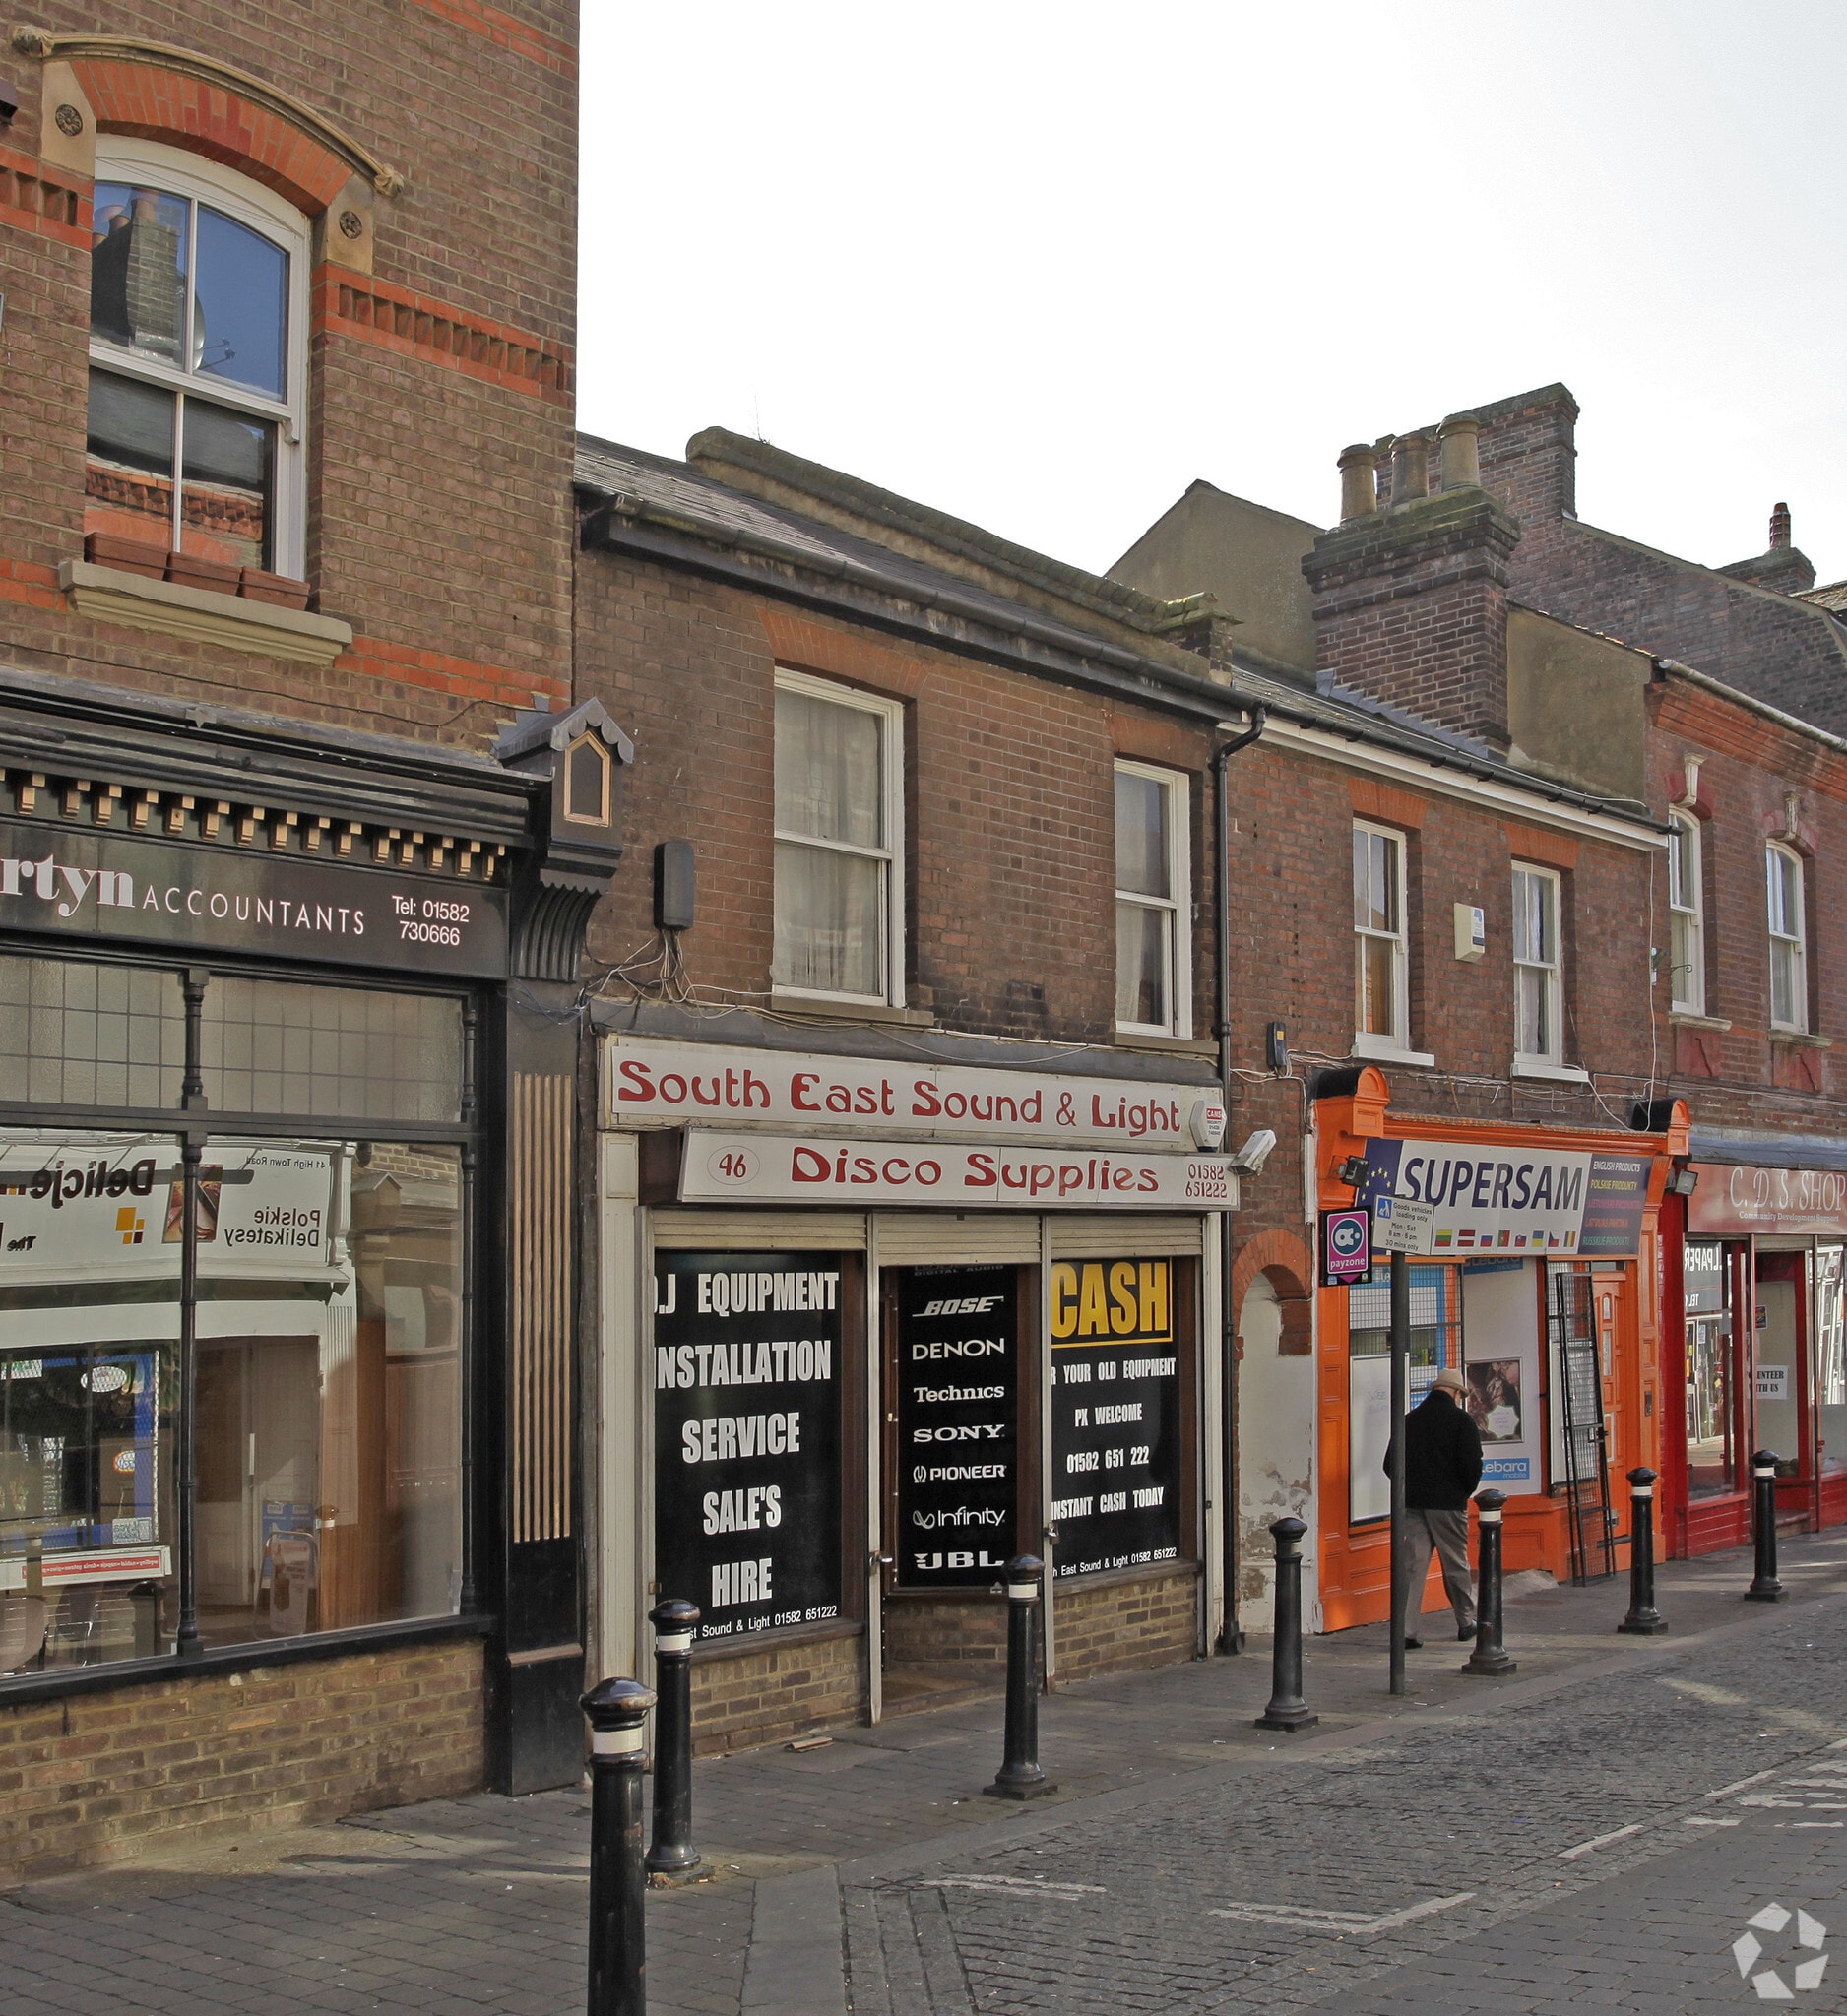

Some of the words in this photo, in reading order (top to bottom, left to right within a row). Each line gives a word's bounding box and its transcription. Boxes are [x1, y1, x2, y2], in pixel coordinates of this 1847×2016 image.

[142, 884, 365, 936] ACCOUNTANTS
[392, 894, 417, 918] Tel:
[422, 900, 470, 923] 01582
[400, 920, 461, 946] 730666
[617, 1059, 771, 1109] South
[790, 1072, 895, 1116] East
[912, 1080, 1043, 1124] Sound
[1055, 1092, 1076, 1127] &
[1092, 1094, 1181, 1138] Light
[718, 1153, 747, 1178] 46
[792, 1146, 942, 1186] Disco
[964, 1153, 1160, 1197] Supplies
[1187, 1163, 1225, 1181] 01582
[1615, 1162, 1641, 1172] PRODUCTS
[1185, 1180, 1228, 1199] 651222
[1404, 1156, 1583, 1211] SUPERSAM
[1799, 1170, 1846, 1211] SHOP
[1393, 1202, 1410, 1211] Goods
[1330, 1258, 1366, 1270] payzone
[697, 1271, 840, 1317] EQUIPMENT
[912, 1295, 1004, 1317] BOSE
[1051, 1261, 1168, 1338] CASH
[912, 1337, 1005, 1360] DENON
[654, 1340, 831, 1389] NSTALLATION
[1063, 1362, 1092, 1384] YOUR
[1098, 1361, 1117, 1380] OLD
[1123, 1357, 1177, 1380] EQUIPMENT
[913, 1385, 1005, 1403] Technics
[1075, 1408, 1088, 1427] PX
[1095, 1403, 1143, 1425] WELCOME
[681, 1412, 800, 1464] SERVICE
[913, 1424, 1005, 1443] SONY
[930, 1464, 1006, 1480] PIONEER
[1066, 1451, 1099, 1474] 01582
[1105, 1448, 1124, 1469] 651
[1130, 1446, 1150, 1466] 222
[1482, 1461, 1527, 1473] ebara
[703, 1484, 782, 1536] SALE'S
[938, 1506, 1006, 1526] Infinity
[1051, 1496, 1093, 1521] INSTANT
[1100, 1491, 1126, 1514] CASH
[1133, 1487, 1165, 1508] TODAY
[914, 1550, 1005, 1570] JBL
[1061, 1565, 1076, 1576] East
[1079, 1558, 1101, 1572] Sound
[1104, 1558, 1110, 1568] &
[1113, 1555, 1128, 1569] Light
[1131, 1551, 1151, 1564] 01582
[1154, 1546, 1177, 1560] 651222
[711, 1557, 773, 1607] HIRE
[702, 1622, 732, 1638] Sound
[736, 1619, 743, 1632] &
[748, 1617, 771, 1631] Light
[775, 1610, 801, 1626] 01582
[805, 1605, 837, 1620] 651222
